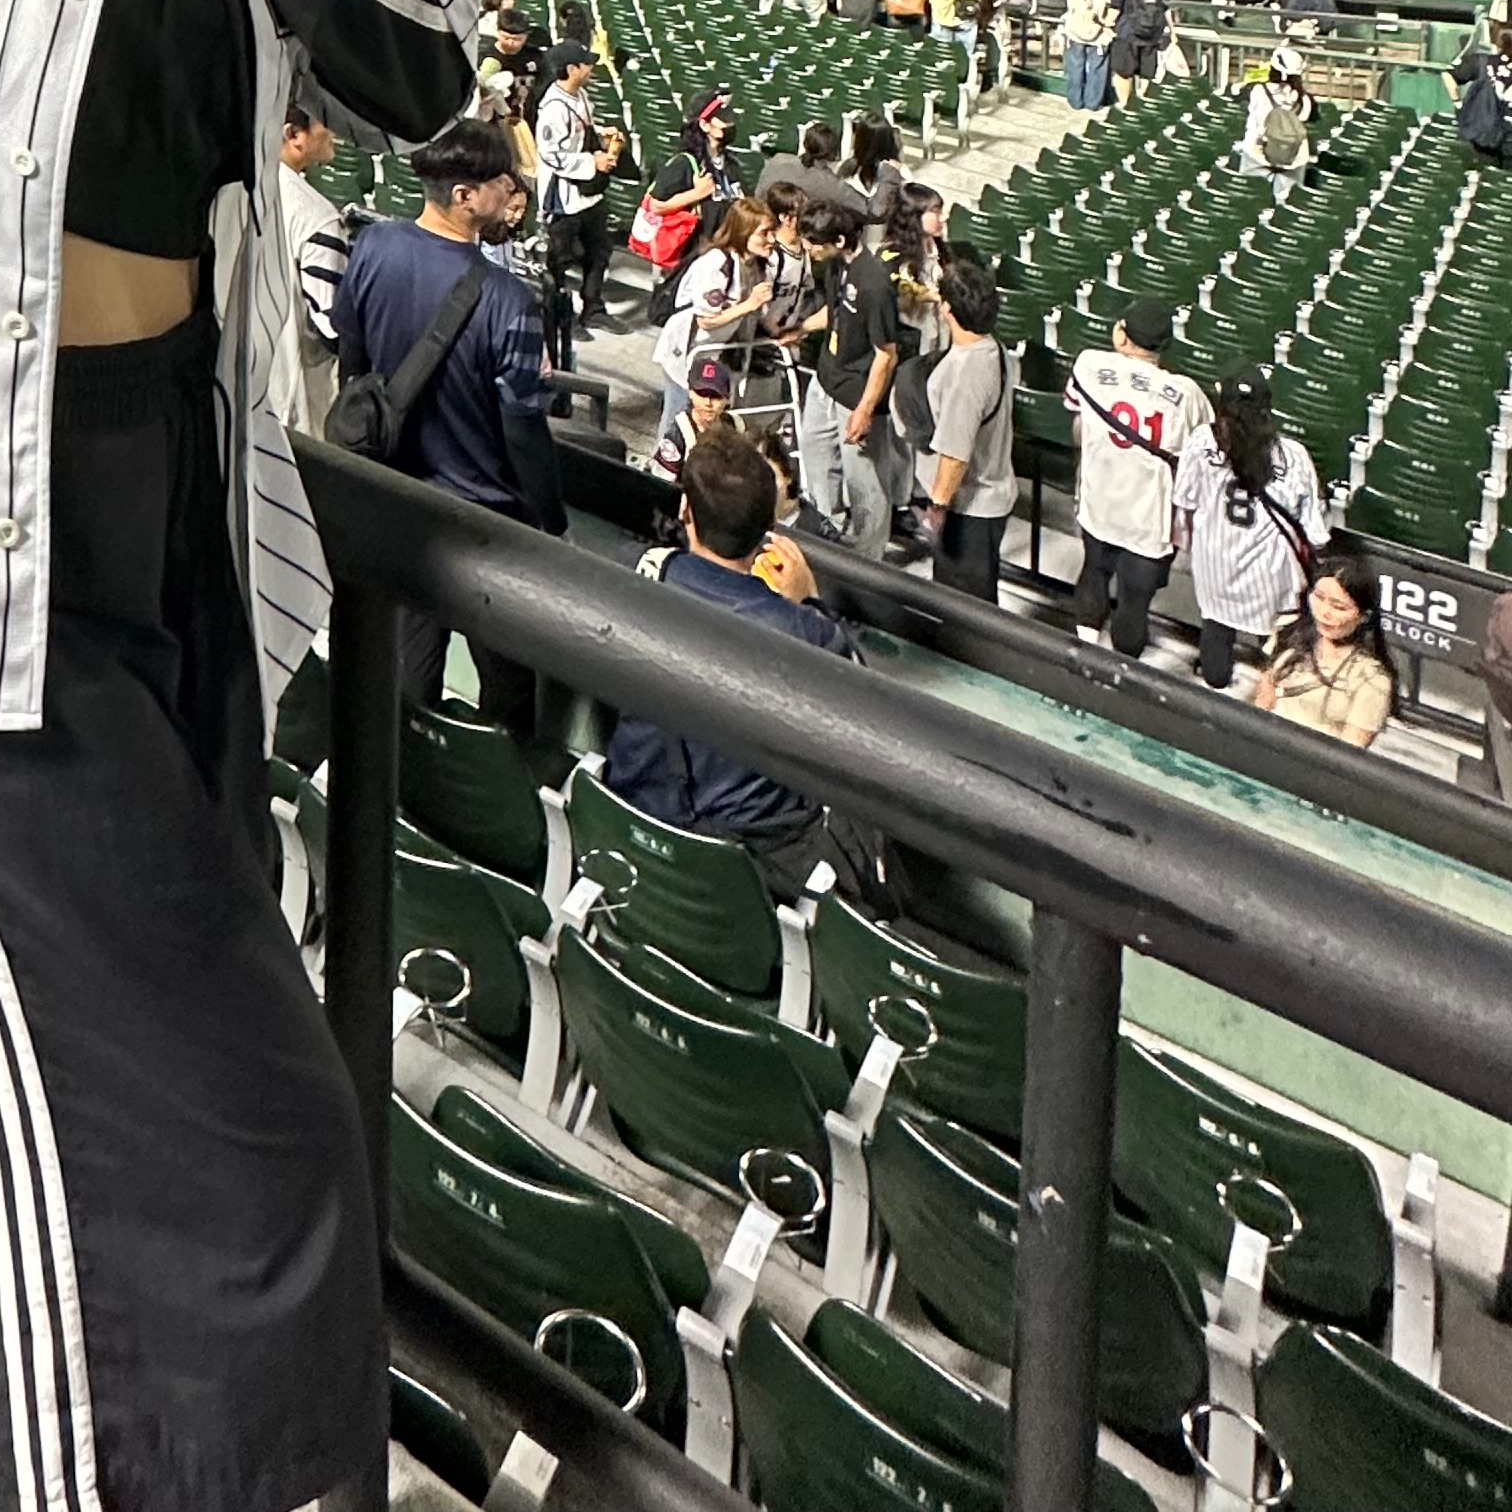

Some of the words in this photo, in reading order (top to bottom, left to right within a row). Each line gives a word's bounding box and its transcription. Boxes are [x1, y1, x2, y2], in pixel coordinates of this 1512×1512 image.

[1108, 400, 1164, 450] 91
[1378, 574, 1458, 633] 122
[1380, 617, 1452, 652] BLOCK
